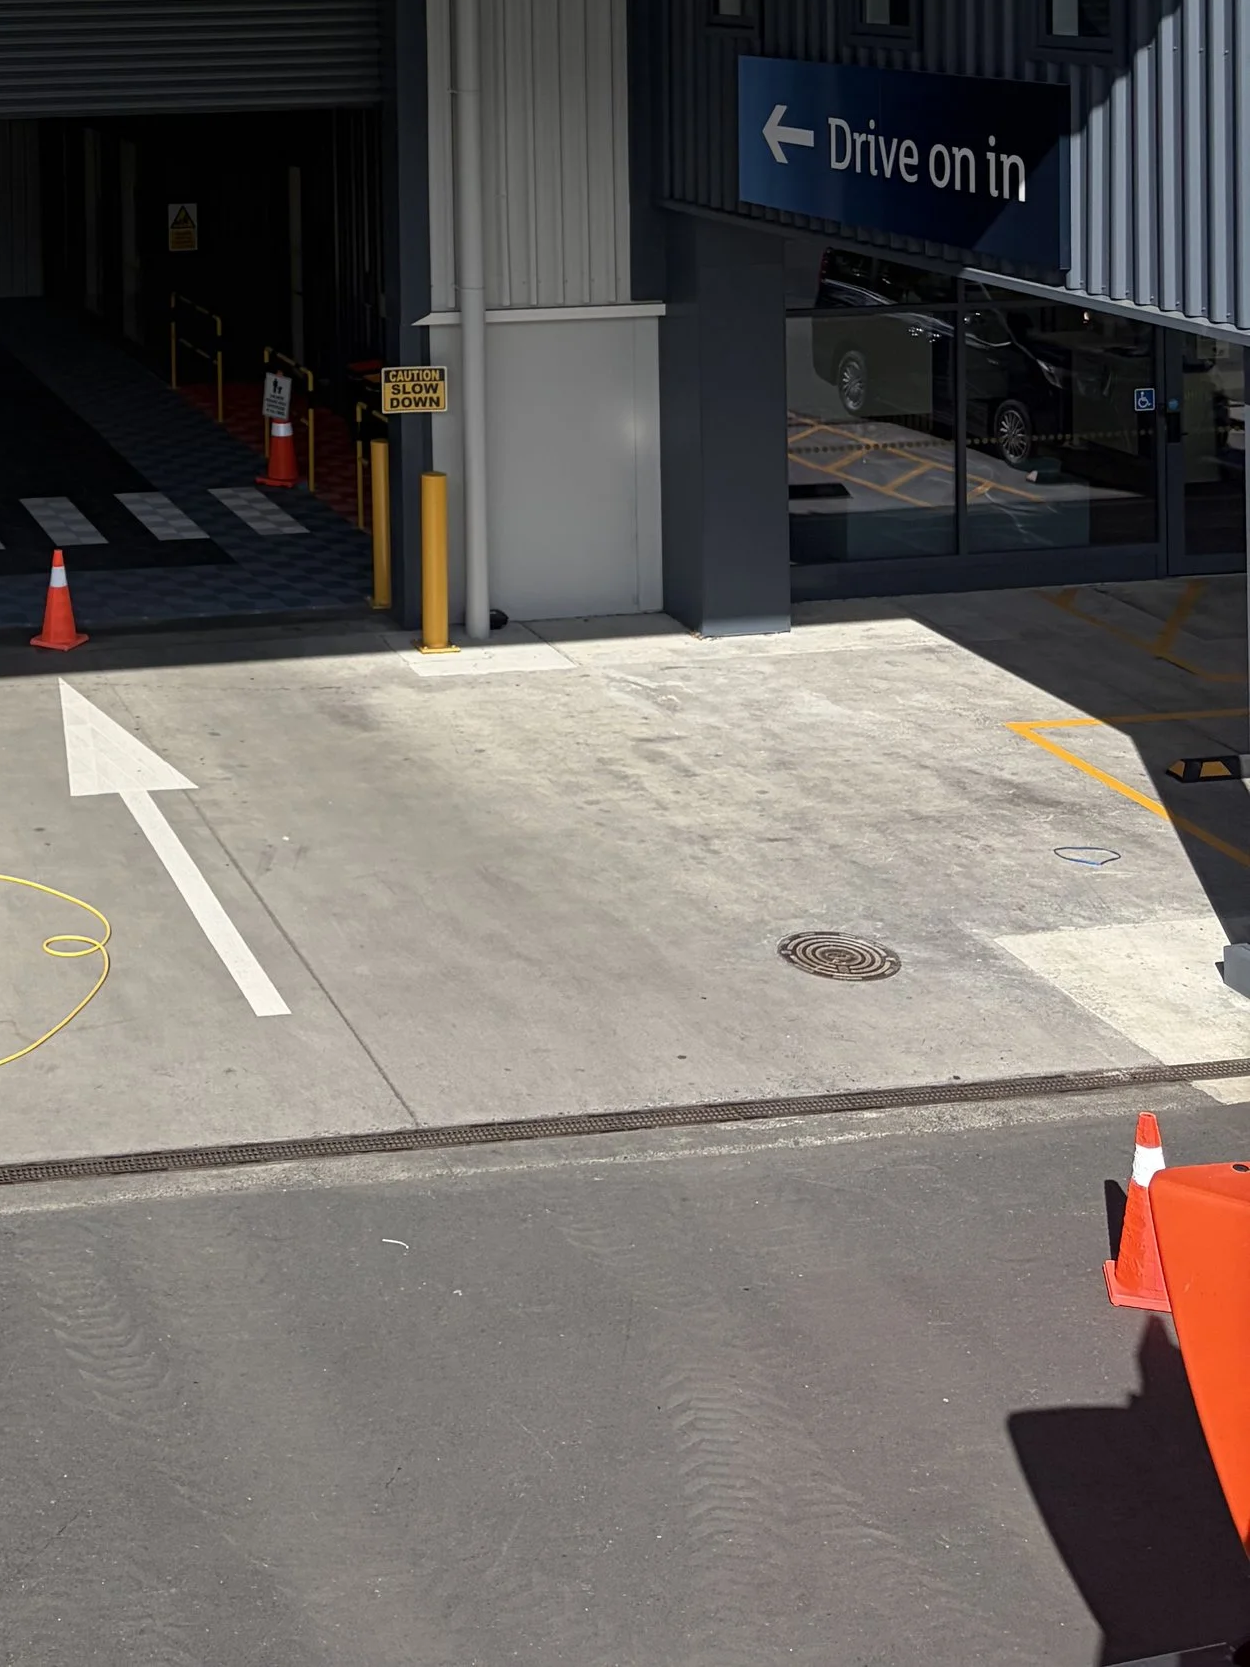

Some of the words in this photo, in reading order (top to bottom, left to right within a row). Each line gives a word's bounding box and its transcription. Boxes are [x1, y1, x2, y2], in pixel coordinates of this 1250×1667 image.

[828, 117, 919, 183] Drive
[929, 143, 976, 193] on
[986, 135, 1026, 203] in
[389, 369, 440, 382] CAUTION
[391, 383, 439, 395] SLOW
[390, 396, 441, 409] DOWN
